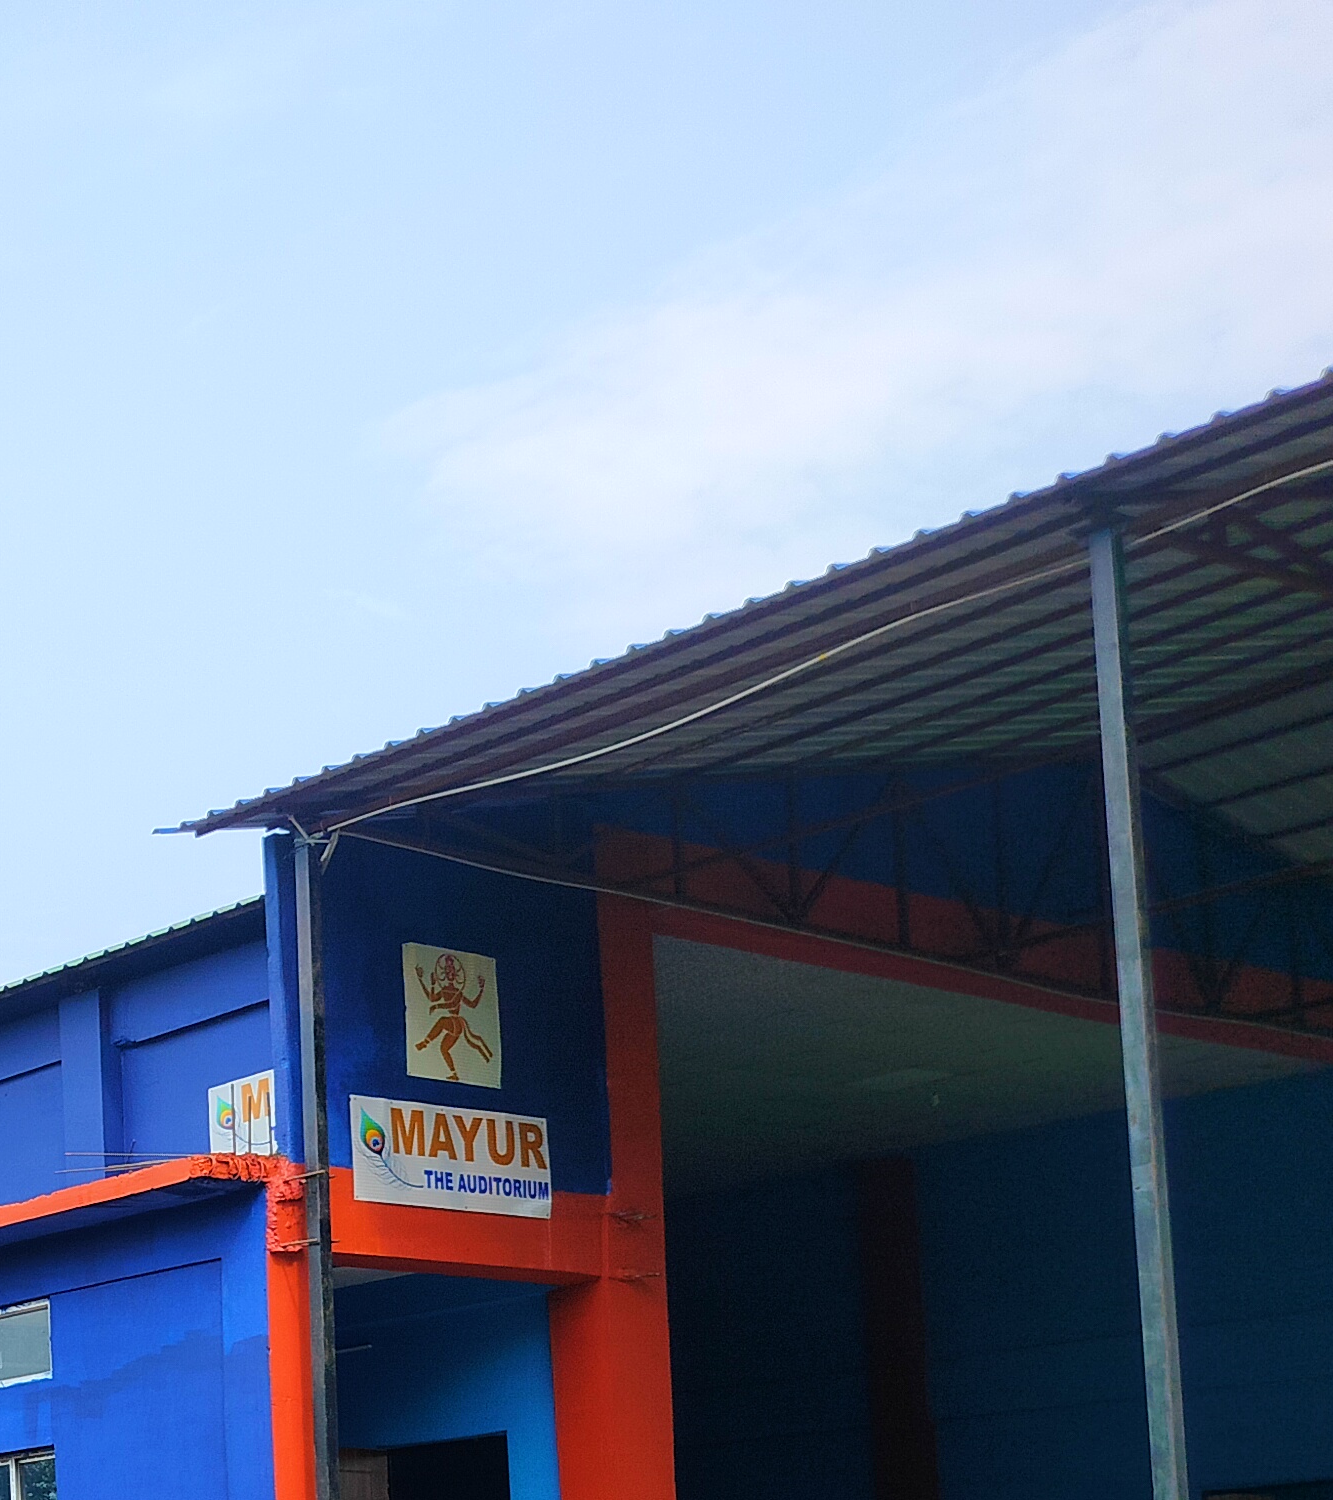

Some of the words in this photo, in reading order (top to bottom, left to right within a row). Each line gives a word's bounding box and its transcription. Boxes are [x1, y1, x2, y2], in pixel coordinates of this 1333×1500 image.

[391, 1108, 548, 1169] MAYUR
[424, 1170, 454, 1191] THE
[458, 1174, 548, 1201] AUDITORIUM
